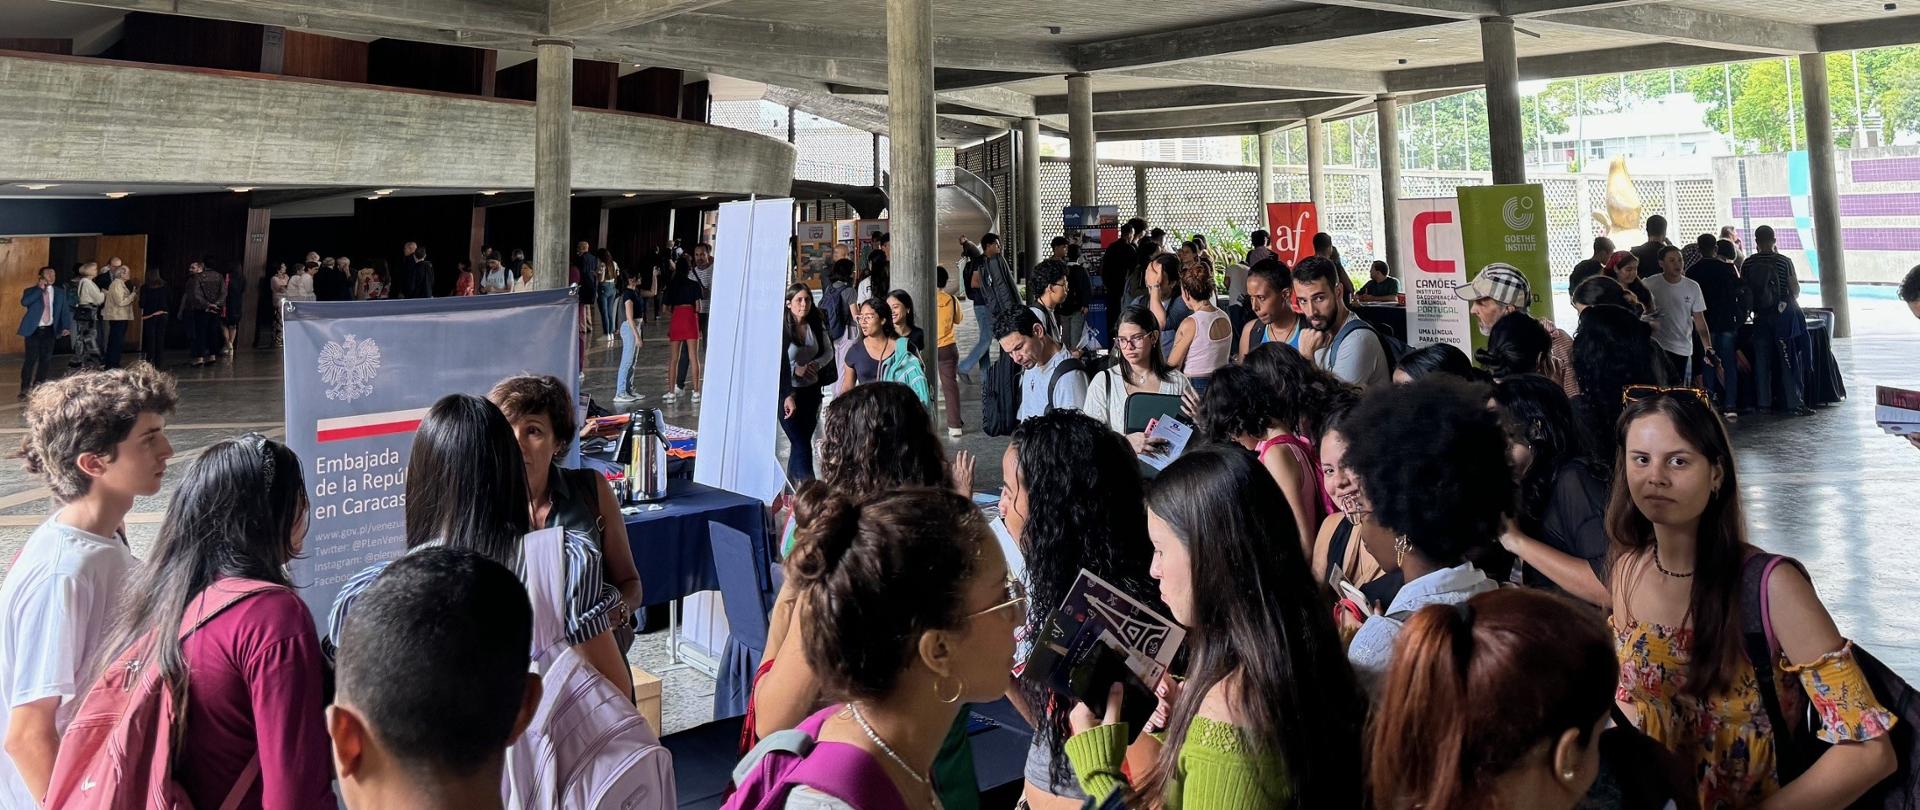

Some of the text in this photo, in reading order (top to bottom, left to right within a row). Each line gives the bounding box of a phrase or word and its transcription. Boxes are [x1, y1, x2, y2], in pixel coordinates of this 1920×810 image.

[1276, 211, 1310, 268] af
[1504, 234, 1537, 243] GOETHE
[1505, 243, 1537, 252] INSTITUT
[1416, 278, 1457, 289] CAMÕES
[1417, 306, 1459, 314] PORTUGAL
[316, 448, 399, 475] Embajada
[315, 479, 337, 497] de
[343, 475, 357, 493] la
[315, 493, 407, 520] en Caracas
[314, 555, 362, 572] Instagram:
